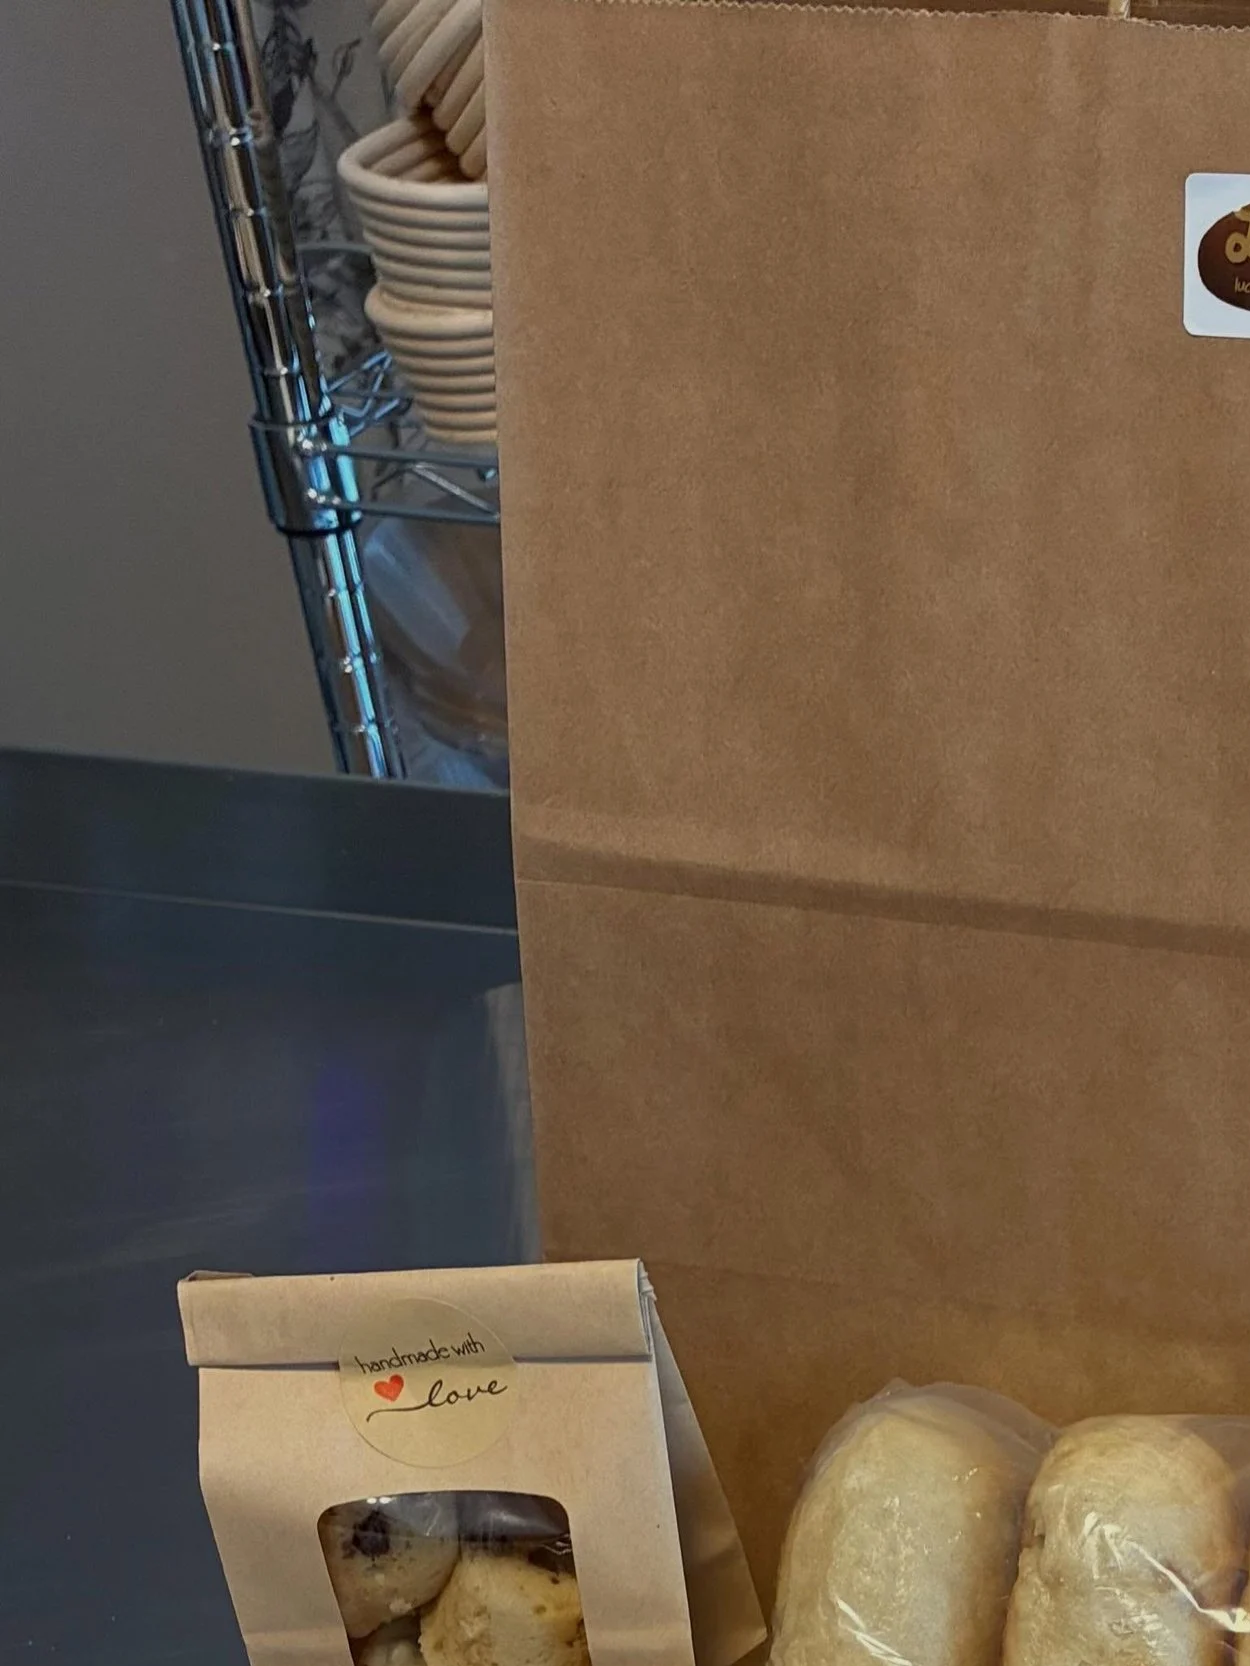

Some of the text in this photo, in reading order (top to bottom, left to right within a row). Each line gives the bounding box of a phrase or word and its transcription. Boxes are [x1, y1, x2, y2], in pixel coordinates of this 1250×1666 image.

[354, 1332, 486, 1375] handmade with
[366, 1379, 508, 1423] love
